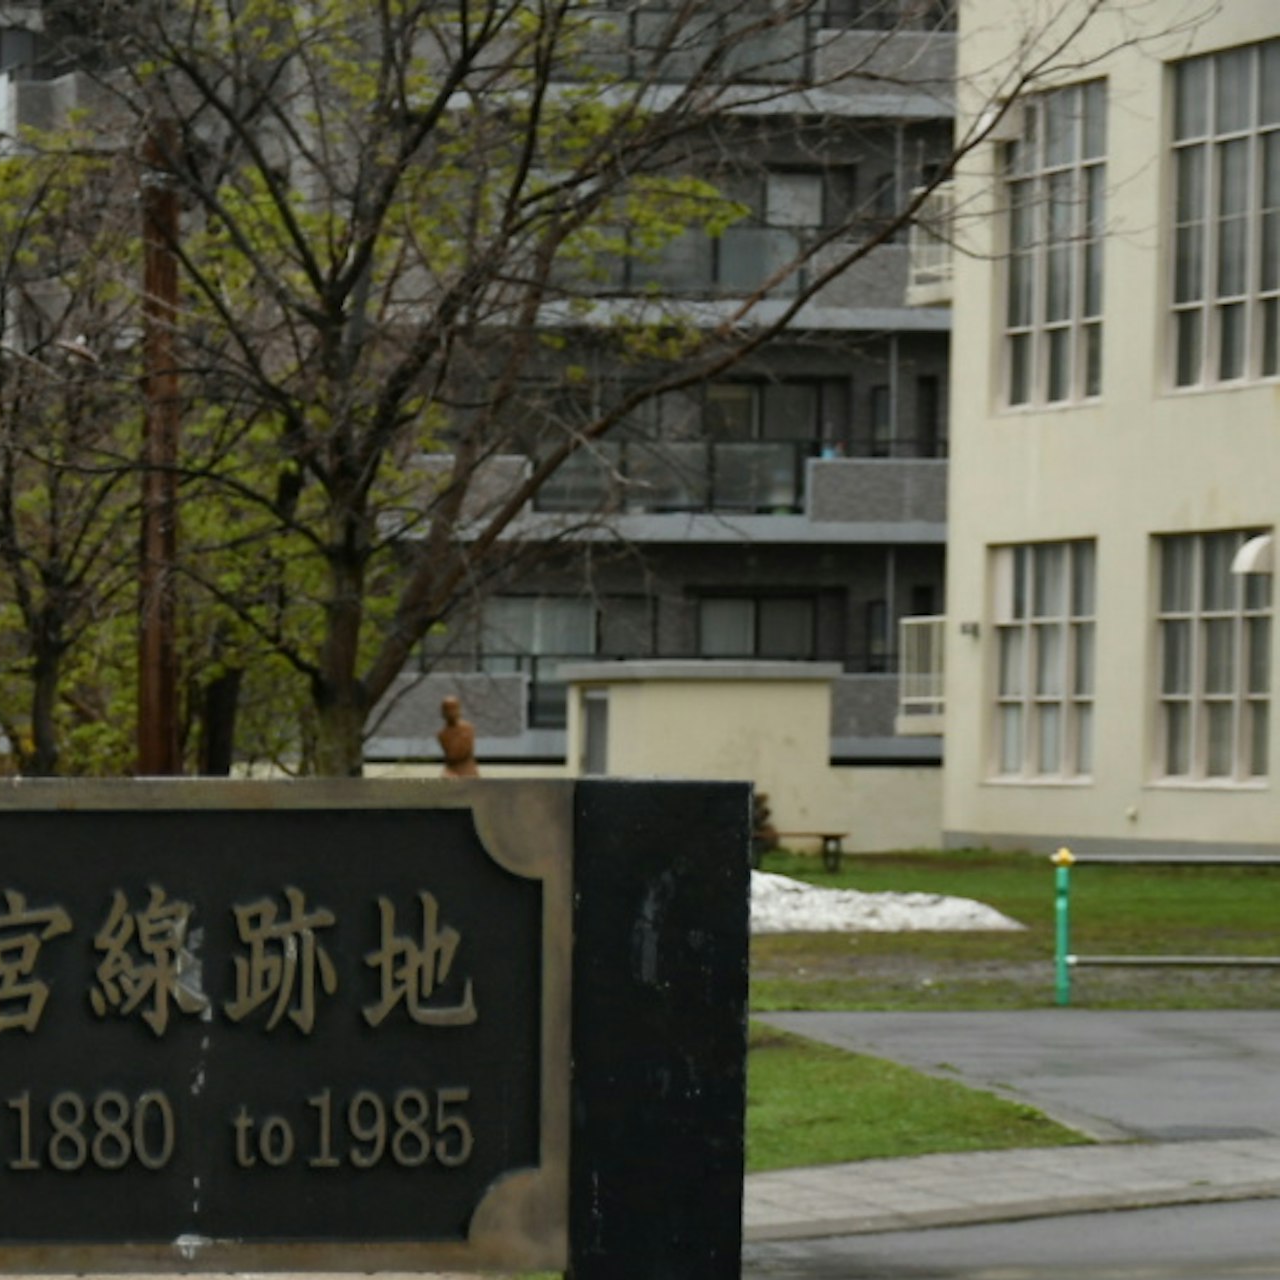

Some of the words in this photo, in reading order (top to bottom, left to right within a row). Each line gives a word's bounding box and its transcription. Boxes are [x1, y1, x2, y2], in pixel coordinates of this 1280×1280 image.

[8, 1090, 175, 1170] 1880
[234, 1102, 295, 1167] to
[307, 1087, 475, 1167] 1985
